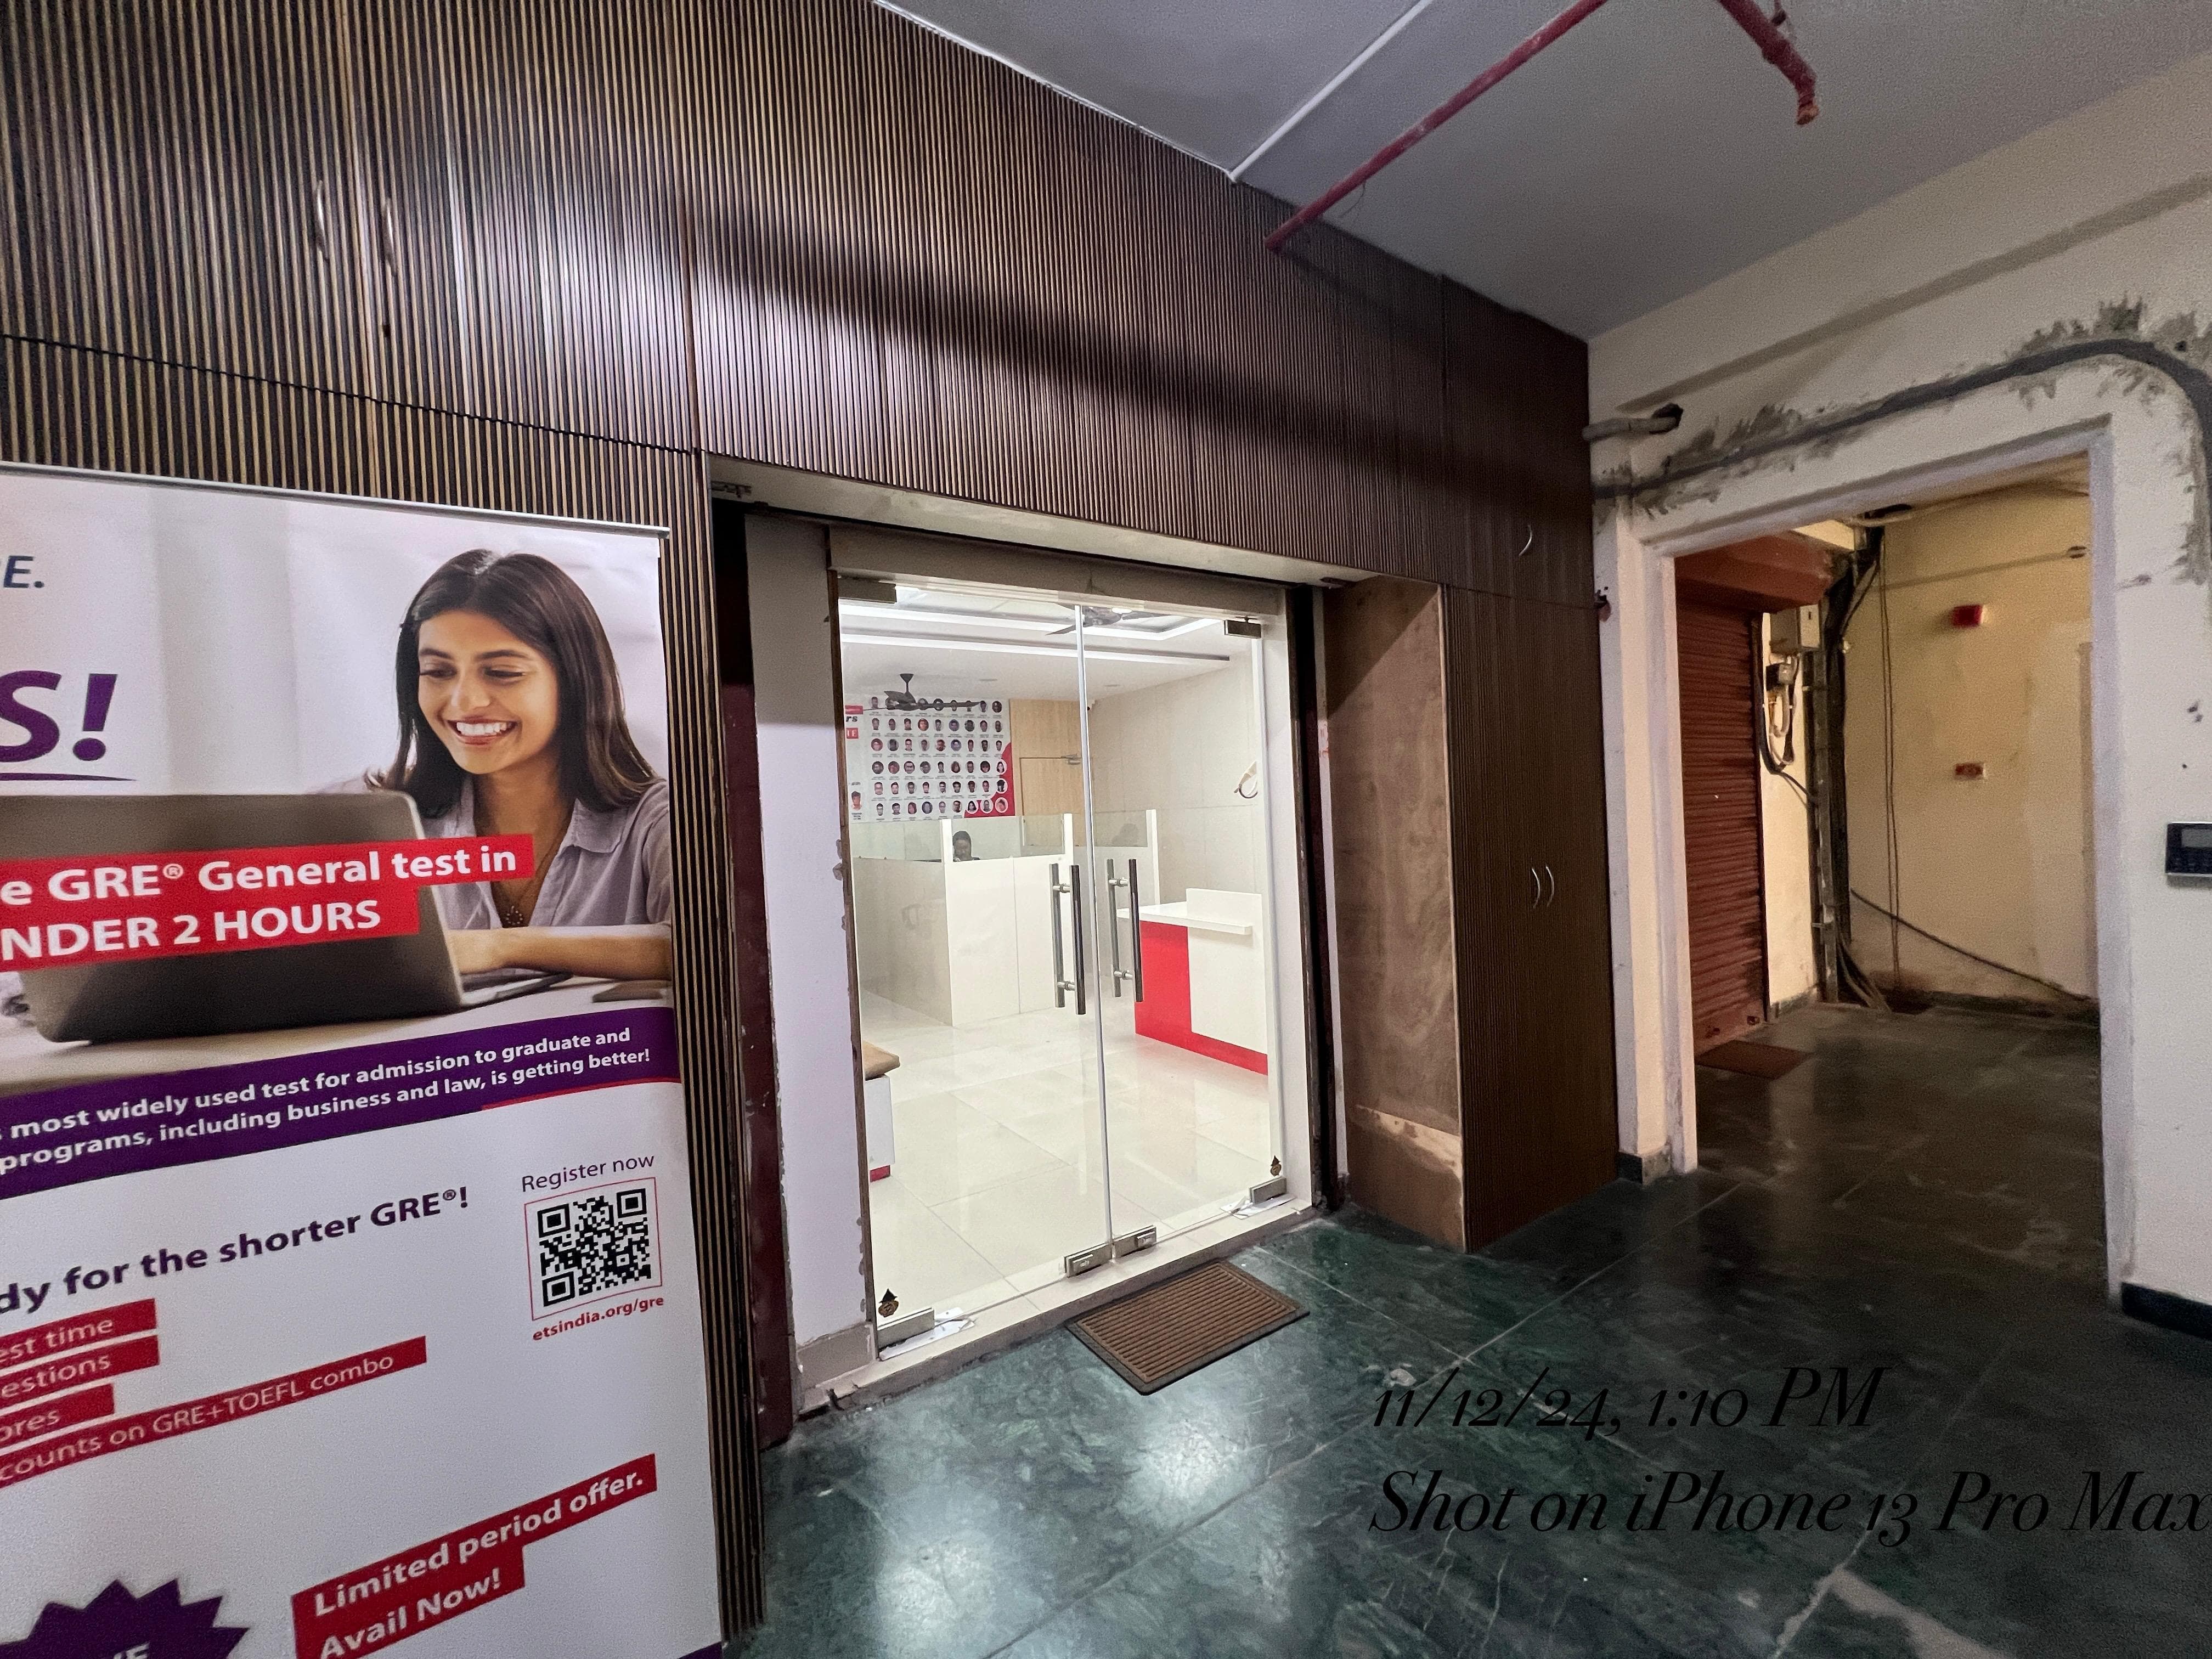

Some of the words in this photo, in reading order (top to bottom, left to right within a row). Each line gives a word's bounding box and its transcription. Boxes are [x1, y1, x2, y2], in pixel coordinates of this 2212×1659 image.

[0, 670, 117, 763] S!
[198, 851, 380, 891] General
[391, 849, 471, 878] test
[481, 845, 516, 873] in
[1, 917, 160, 961] NDER
[172, 915, 201, 945] 2
[214, 900, 381, 941] HOURS
[0, 1131, 154, 1175] programs,
[160, 1111, 281, 1141] including
[287, 1092, 391, 1121] business
[396, 1081, 438, 1102] and
[444, 1076, 487, 1094] law,
[490, 1070, 508, 1086] is
[512, 1059, 584, 1085] getting
[588, 1048, 650, 1069] better!
[10, 1109, 89, 1139] most
[97, 1096, 189, 1122] widely
[195, 1084, 255, 1108] used
[261, 1077, 310, 1098] test
[314, 1073, 351, 1090] for
[356, 1054, 470, 1083] admission
[474, 1049, 497, 1064] to
[501, 1038, 591, 1063] graduate
[595, 1027, 631, 1046] and
[522, 1162, 607, 1192] Register
[613, 1155, 654, 1172] now
[63, 1263, 129, 1296] for
[140, 1248, 208, 1277] the
[219, 1214, 361, 1263] shorter
[46, 1319, 114, 1349] time
[532, 1296, 664, 1341] etsindia.org/gre
[1, 1355, 111, 1398] estions
[0, 1436, 103, 1481] counts
[109, 1425, 145, 1445] on
[153, 1380, 305, 1434] GRE+TOEFL
[309, 1356, 394, 1391] combo
[314, 1544, 449, 1616] Limited
[459, 1497, 561, 1564] period
[569, 1471, 643, 1514] offer.
[320, 1605, 407, 1659] Avail
[417, 1567, 500, 1620] Now!
